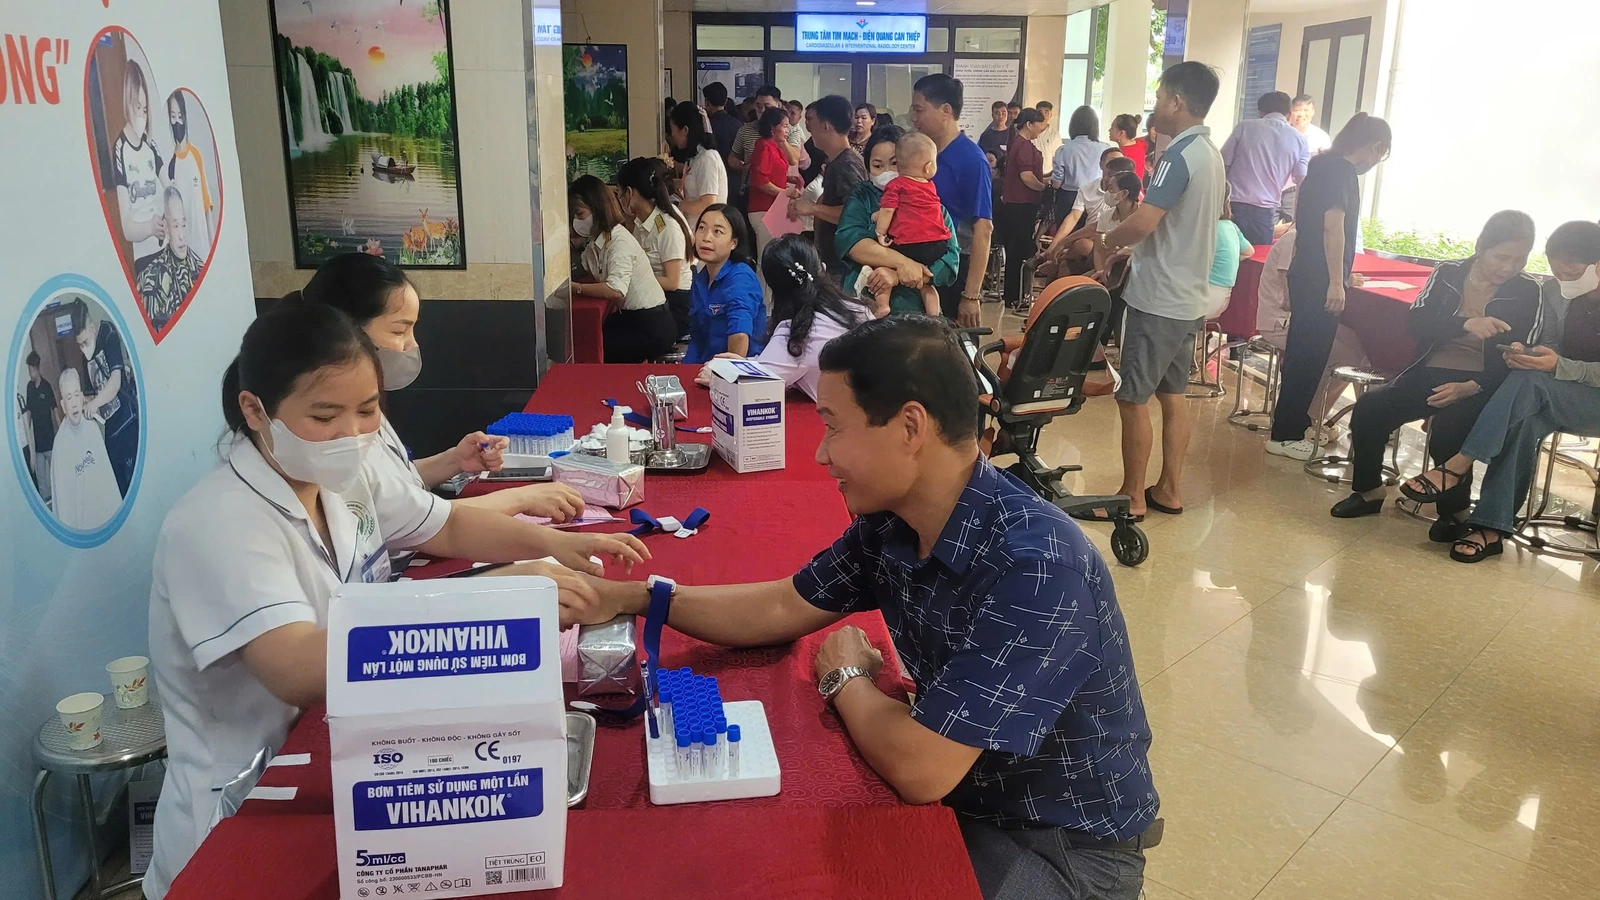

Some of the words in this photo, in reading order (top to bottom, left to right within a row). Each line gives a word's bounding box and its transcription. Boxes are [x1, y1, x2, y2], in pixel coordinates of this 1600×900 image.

[801, 30, 819, 41] TRUNG
[819, 29, 832, 41] TÂM
[832, 31, 842, 41] TIM
[842, 31, 859, 43] MẠCH
[862, 30, 875, 43] ĐIỆN
[875, 31, 893, 42] QUANG
[894, 31, 905, 42] CAN
[746, 407, 776, 417] VIHANKOK
[388, 624, 509, 655] VIHANKOK
[389, 657, 414, 675] MỘT
[417, 656, 449, 672] DỤNG
[451, 656, 467, 673] SỬ
[470, 655, 498, 670] TIÊM
[500, 653, 527, 666] BƠM
[362, 660, 386, 678] LẦN
[371, 738, 396, 747] KHÔNG
[398, 736, 416, 745] BUỐT
[422, 735, 446, 743] KHÔNG
[447, 734, 462, 742] ĐỘC
[467, 732, 491, 740] KHÔNG
[493, 731, 507, 739] GÂY
[508, 729, 521, 737] SỐT
[474, 740, 501, 761] CE
[373, 752, 404, 765] ISO
[502, 755, 522, 764] 0197
[367, 785, 394, 799] BƠM
[397, 781, 425, 797] TIÊM
[427, 778, 445, 795] SỬ
[446, 778, 477, 795] DỤNG
[480, 774, 504, 791] MỘT
[507, 771, 529, 787] LẦN
[386, 793, 506, 825] VIHANKOK
[503, 857, 525, 865] TRÙNG
[530, 855, 542, 863] EO
[356, 869, 374, 877] CÔNG
[414, 864, 448, 872] TANAPHAR
